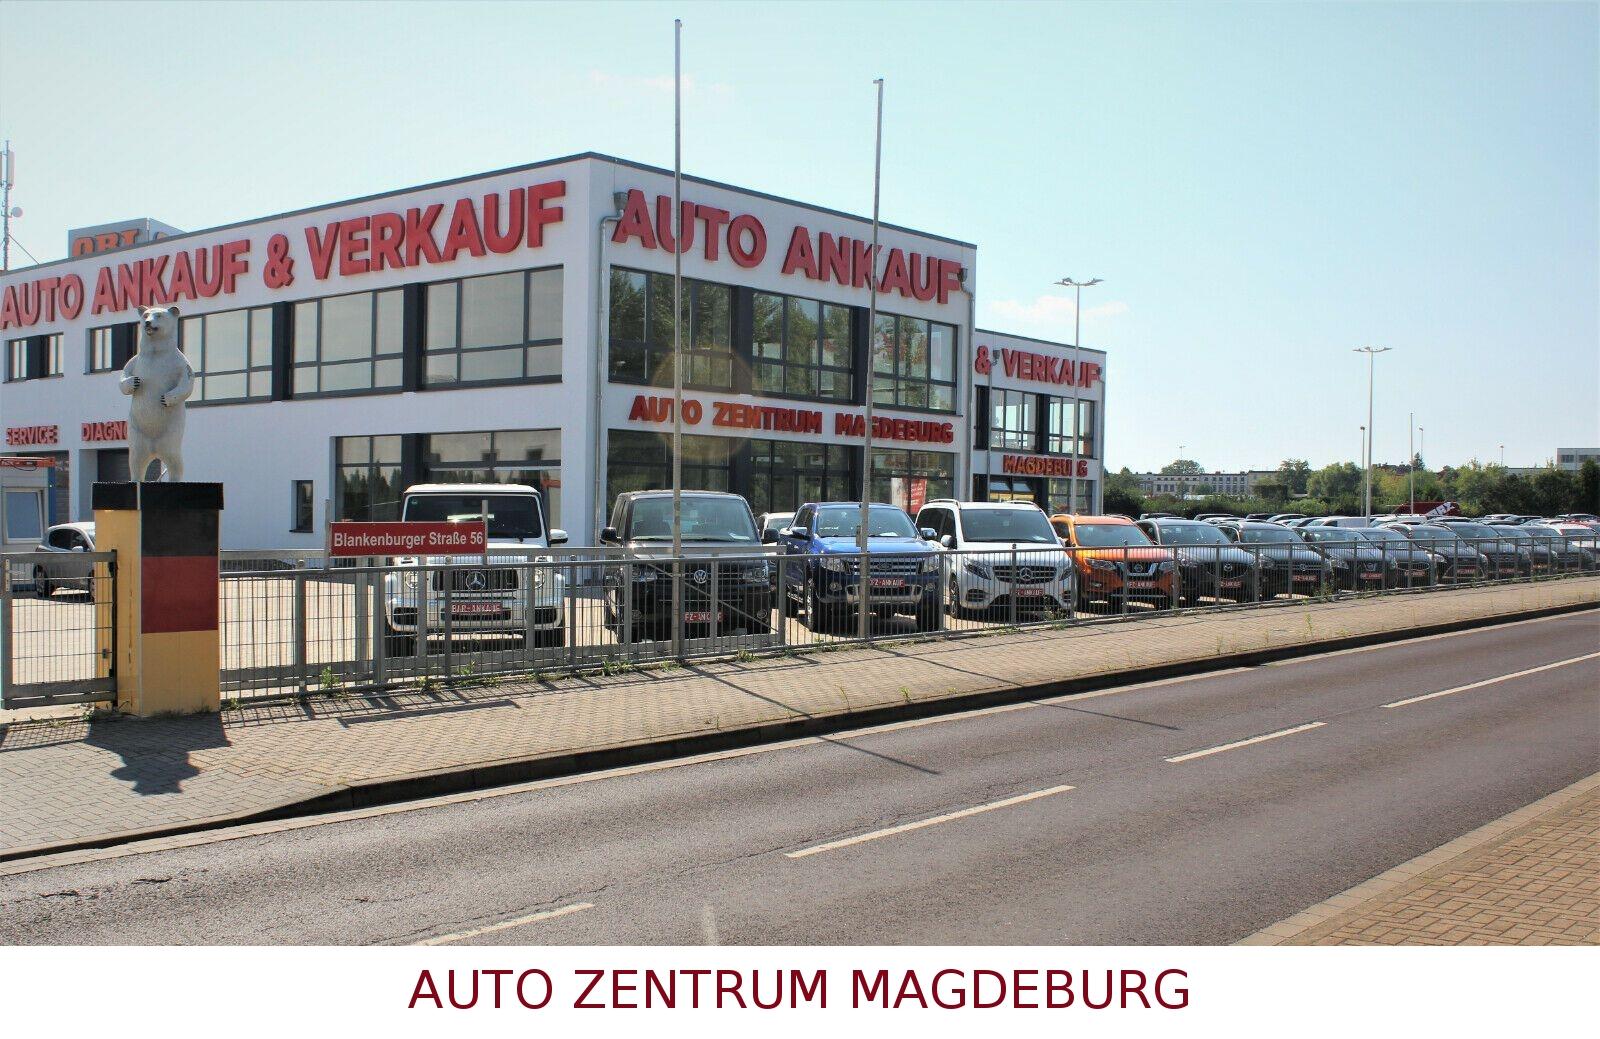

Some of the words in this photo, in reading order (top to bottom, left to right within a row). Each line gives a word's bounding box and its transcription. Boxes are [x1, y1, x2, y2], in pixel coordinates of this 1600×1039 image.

[0, 274, 84, 330] AUTO
[91, 239, 250, 315] ANKAUF
[263, 233, 294, 289] &
[304, 180, 566, 280] VERKAUF
[611, 188, 767, 268] AUTO
[781, 225, 962, 304] ANKAUF
[975, 345, 991, 375] &
[6, 424, 58, 445] SERVICE
[81, 421, 128, 441] DIAGN
[712, 401, 822, 434] ZENTRUM
[835, 412, 954, 443] MAGDEBURG
[1003, 454, 1088, 477] MAGDEBUG
[333, 532, 425, 549] Blankenburger
[429, 531, 467, 545] Straße
[470, 531, 484, 545] 56
